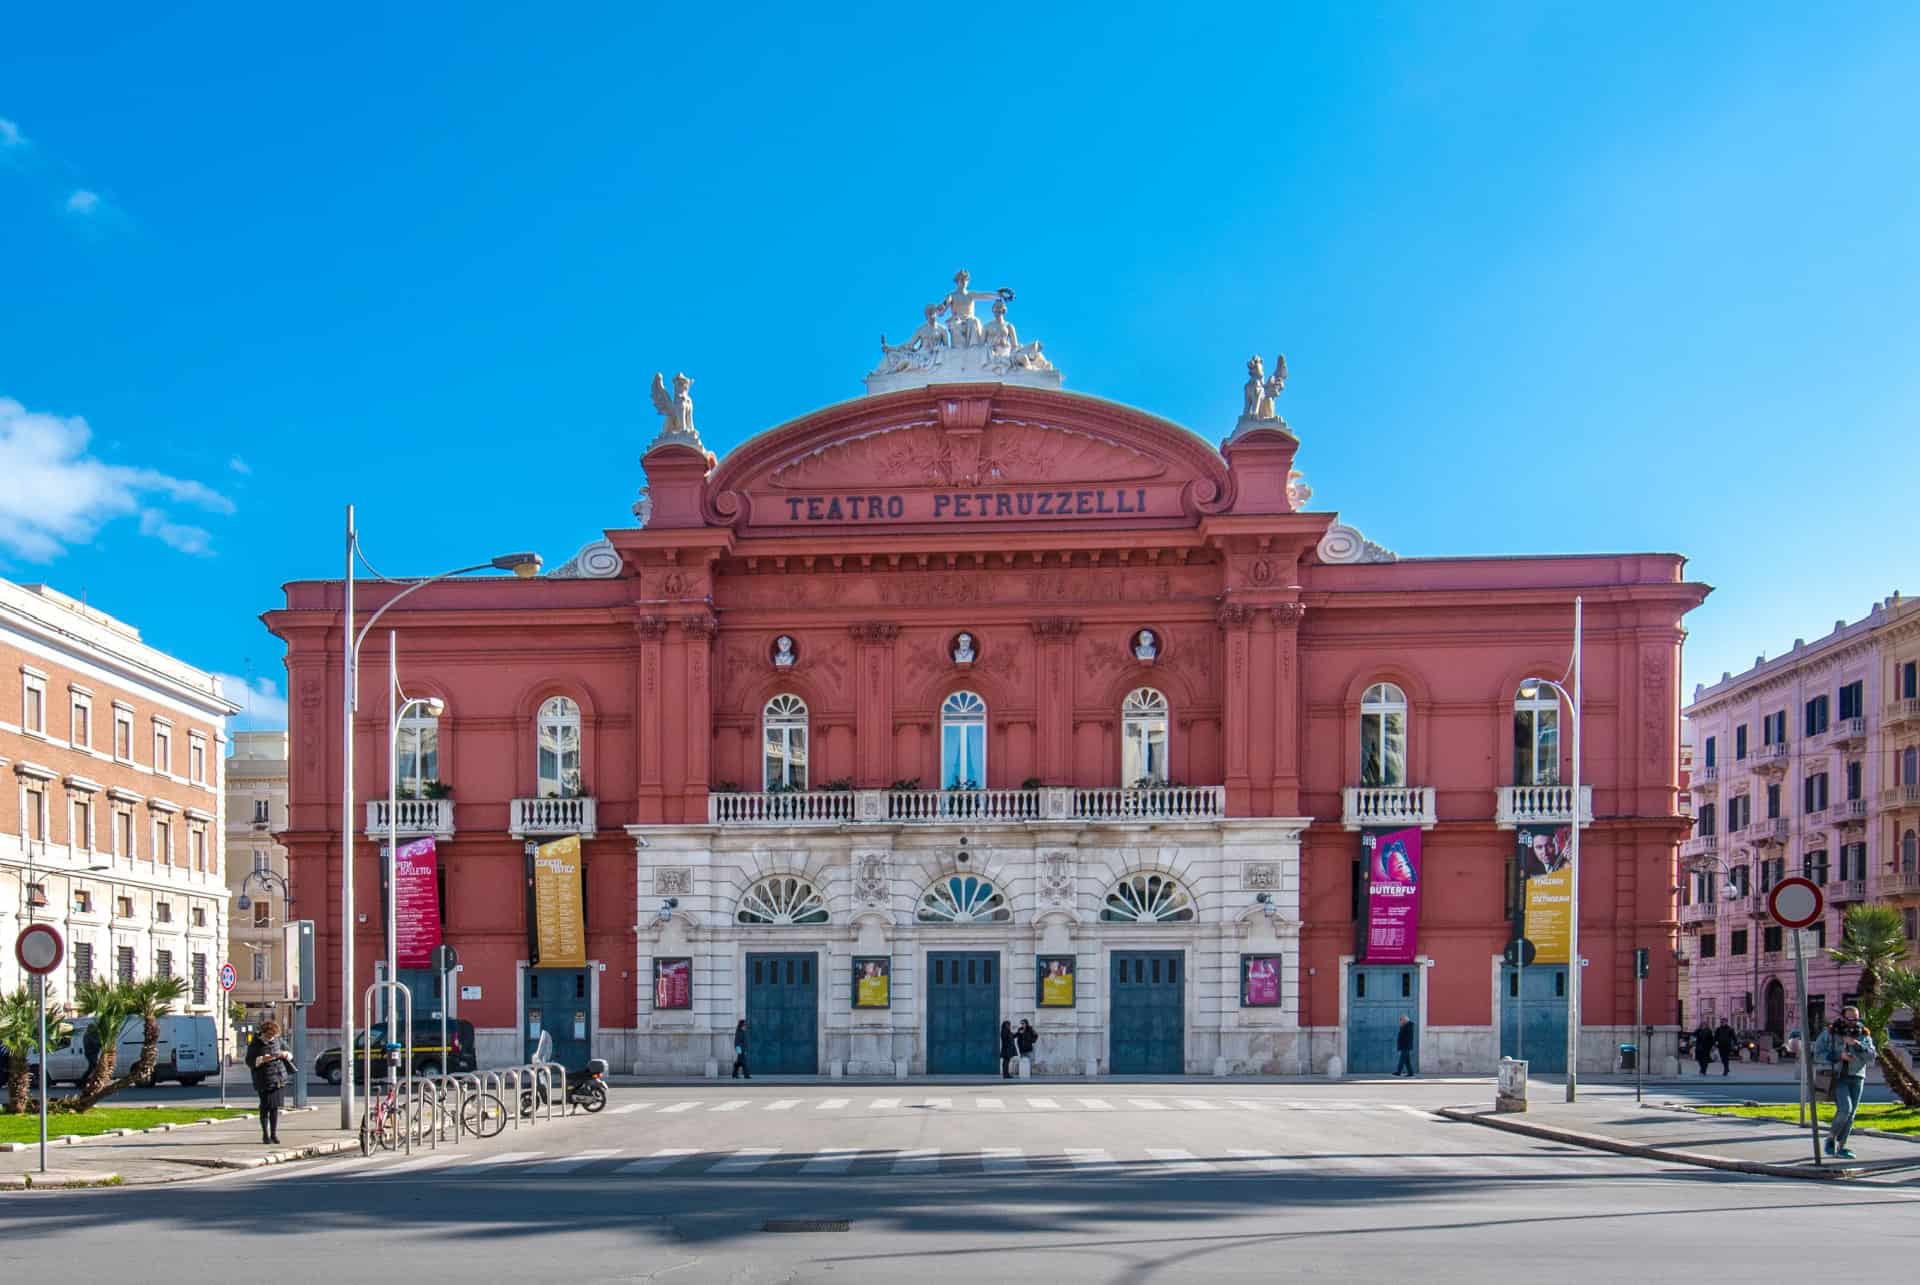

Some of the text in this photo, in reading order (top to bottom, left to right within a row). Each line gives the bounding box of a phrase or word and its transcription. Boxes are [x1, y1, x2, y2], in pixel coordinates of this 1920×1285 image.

[786, 489, 1146, 520] TEATRO PETRUZZELLI
[1370, 886, 1417, 895] BUTTERFLY
